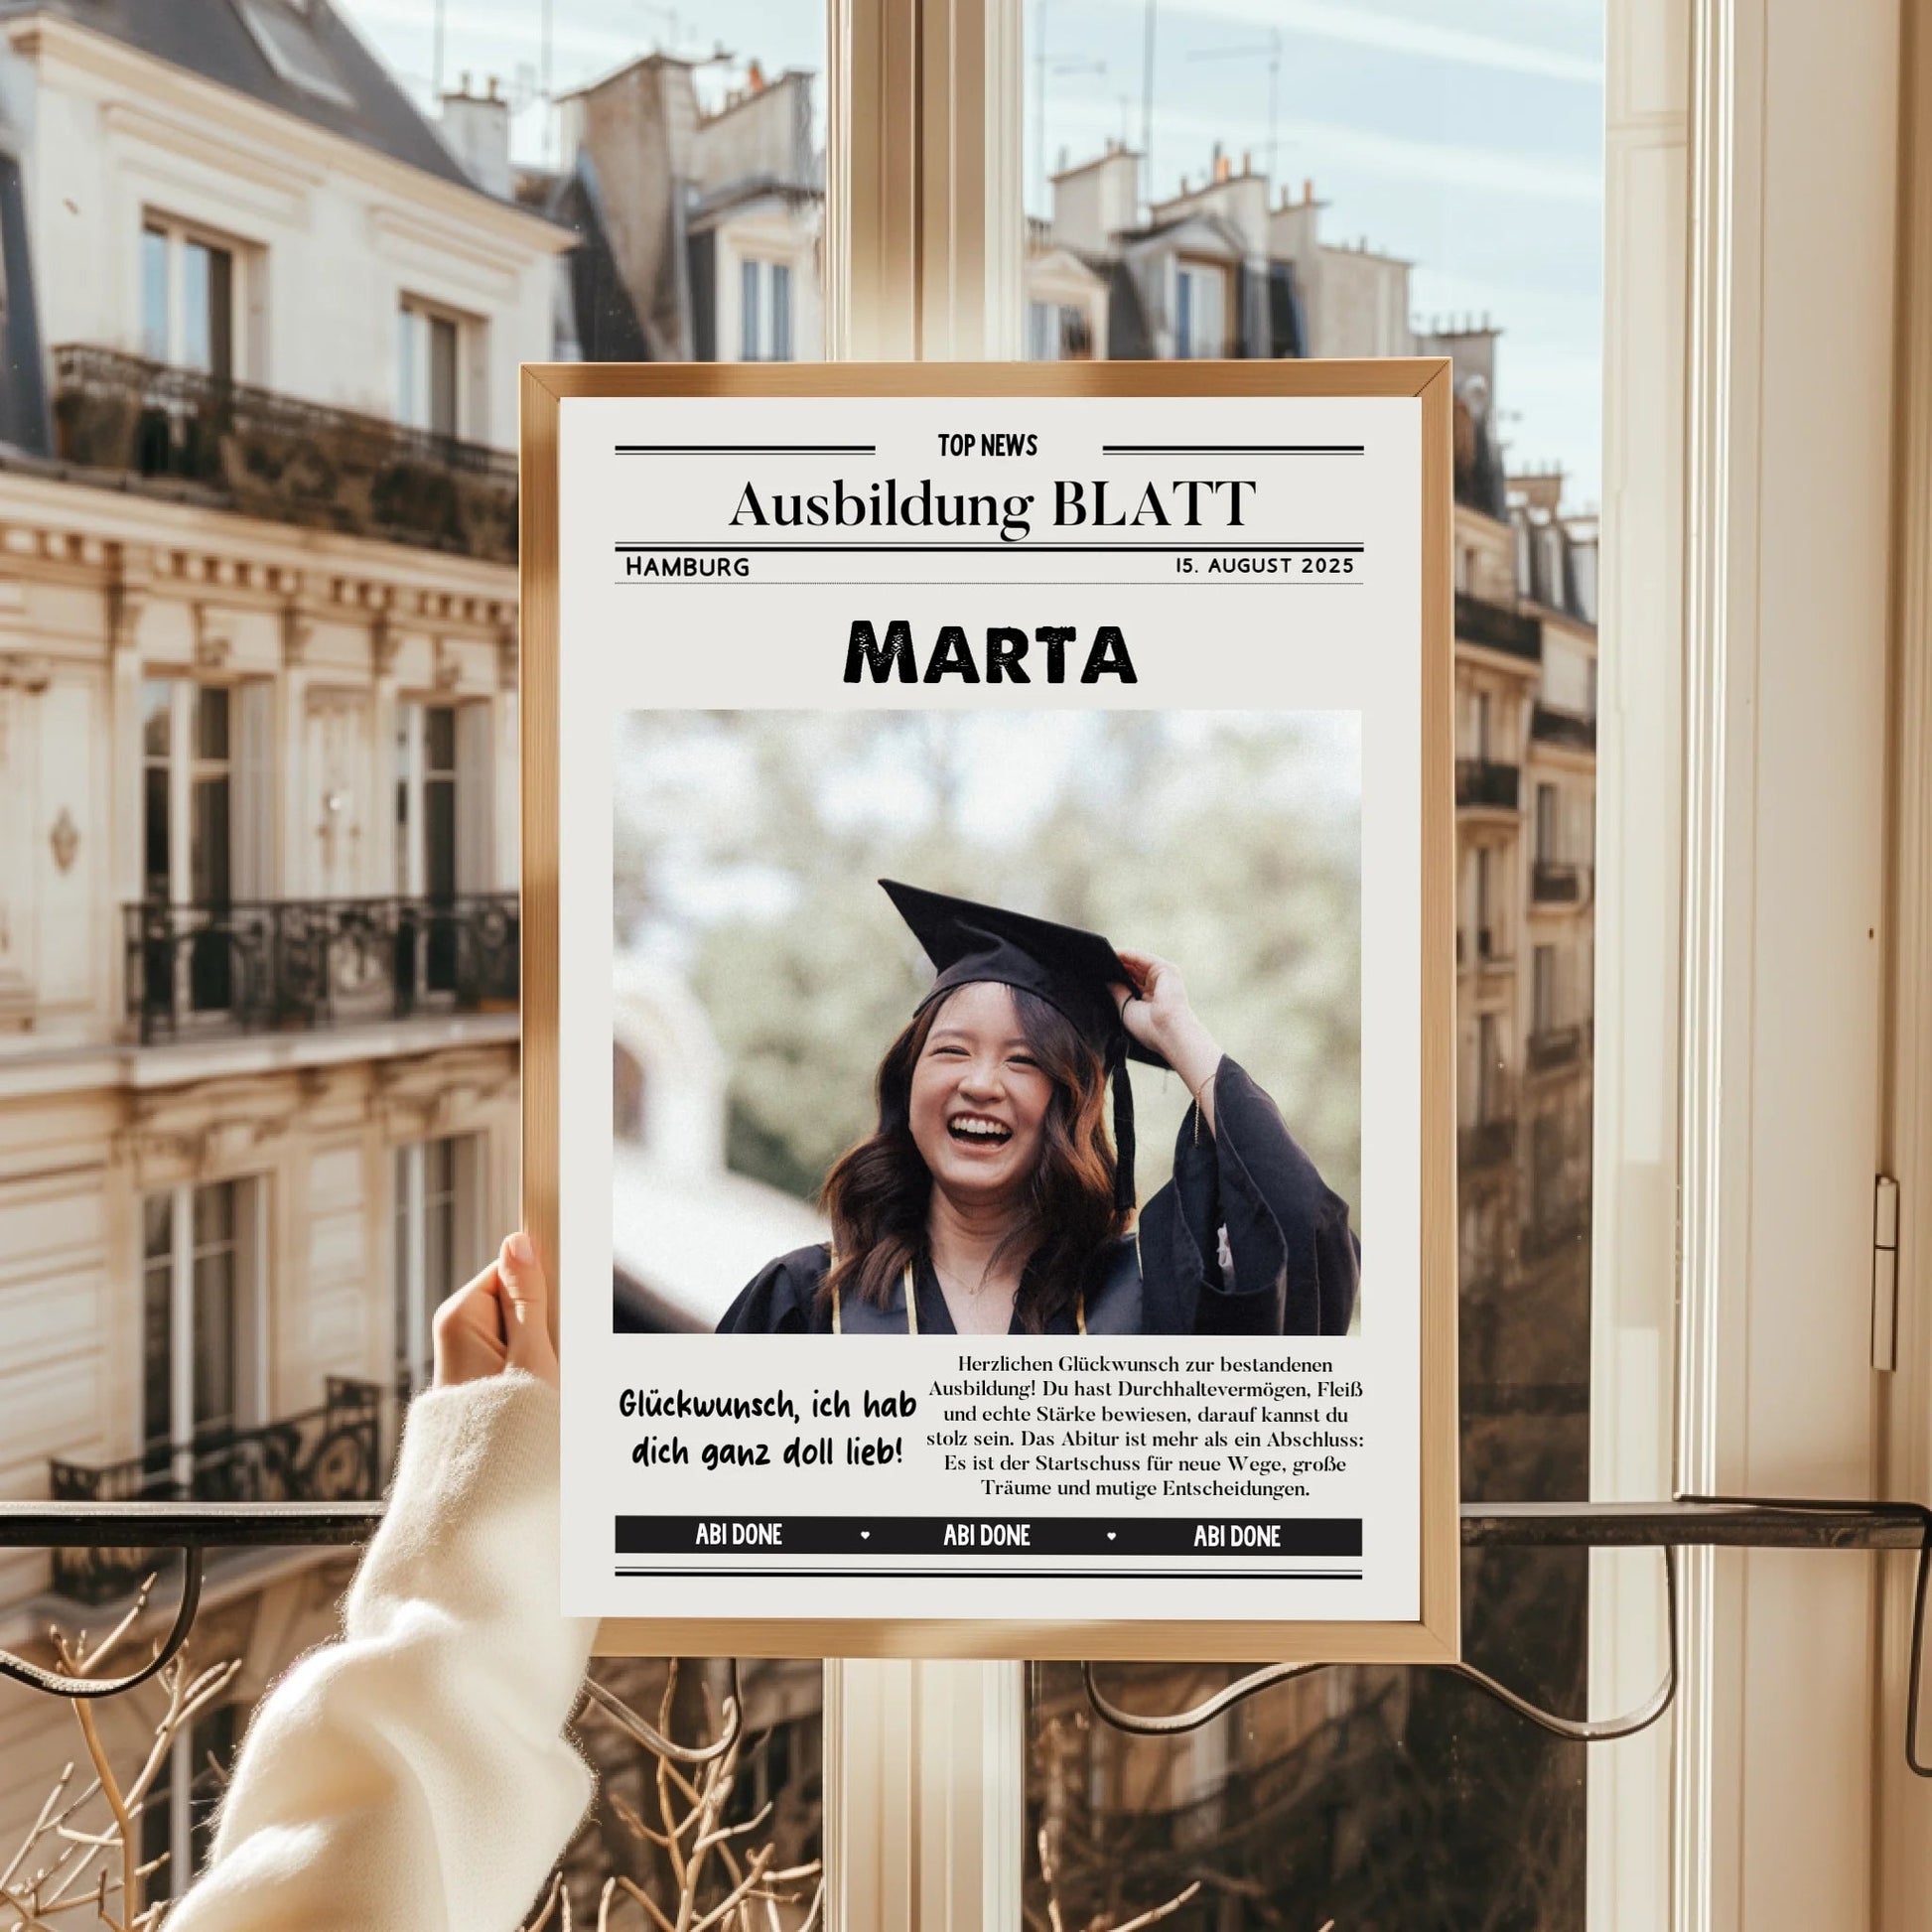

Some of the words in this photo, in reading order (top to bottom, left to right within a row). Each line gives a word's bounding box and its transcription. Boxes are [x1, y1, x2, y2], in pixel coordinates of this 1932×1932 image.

[938, 434, 975, 456] TOP
[982, 434, 1037, 456] NEWS
[729, 479, 1035, 542] Ausbildung
[1053, 482, 1256, 525] BLATT
[626, 556, 749, 576] HAMBURG
[1177, 558, 1197, 573] 15.
[1208, 558, 1292, 573] AUGUST
[1302, 558, 1353, 573] 2025
[843, 621, 1138, 683] MARTA
[959, 1355, 1052, 1371] Herzlichen
[1059, 1356, 1178, 1371] Glückwunsch
[1186, 1361, 1214, 1372] zur
[1221, 1356, 1332, 1372] bestandenen
[929, 1380, 1035, 1400] Ausbildung!
[1043, 1381, 1067, 1396] Du
[1075, 1381, 1111, 1396] hast
[1119, 1381, 1311, 1401] Durchhaltevermögen,
[1318, 1381, 1362, 1397] Fleiß
[620, 1389, 799, 1424] Glückwunsch,
[813, 1390, 850, 1418] ich
[864, 1390, 916, 1418] hab
[944, 1406, 976, 1421] und
[983, 1406, 1031, 1421] echte
[1037, 1406, 1095, 1421] Stärke
[1102, 1406, 1190, 1423] bewiesen,
[1198, 1407, 1257, 1422] darauf
[1262, 1407, 1319, 1422] kannst
[1326, 1407, 1347, 1422] du
[927, 1430, 967, 1446] stolz
[974, 1432, 1014, 1446] sein.
[1022, 1431, 1054, 1446] Das
[1062, 1431, 1119, 1446] Abitur
[1126, 1432, 1146, 1446] ist
[1153, 1431, 1198, 1447] mehr
[1205, 1432, 1227, 1447] als
[1235, 1433, 1261, 1447] ein
[1267, 1432, 1363, 1447] Abschluss:
[632, 1436, 688, 1466] dich
[702, 1444, 770, 1470] ganz
[783, 1437, 833, 1467] doll
[847, 1437, 901, 1465] lieb!
[945, 1455, 965, 1469] Es
[974, 1455, 994, 1470] ist
[1001, 1454, 1030, 1470] der
[1036, 1455, 1140, 1470] Startschuss
[1148, 1455, 1173, 1470] für
[1179, 1460, 1220, 1470] neue
[1227, 1456, 1286, 1475] Wege,
[1293, 1456, 1346, 1475] große
[981, 1480, 1051, 1494] Träume
[1058, 1479, 1090, 1495] und
[1096, 1481, 1157, 1500] mutige
[1164, 1480, 1310, 1500] Entscheidungen.
[696, 1523, 727, 1544] ABI
[733, 1523, 782, 1545] DONE
[944, 1524, 974, 1545] ABI
[981, 1524, 1031, 1546] DONE
[1194, 1525, 1224, 1546] ABI
[1231, 1525, 1281, 1547] DONE
